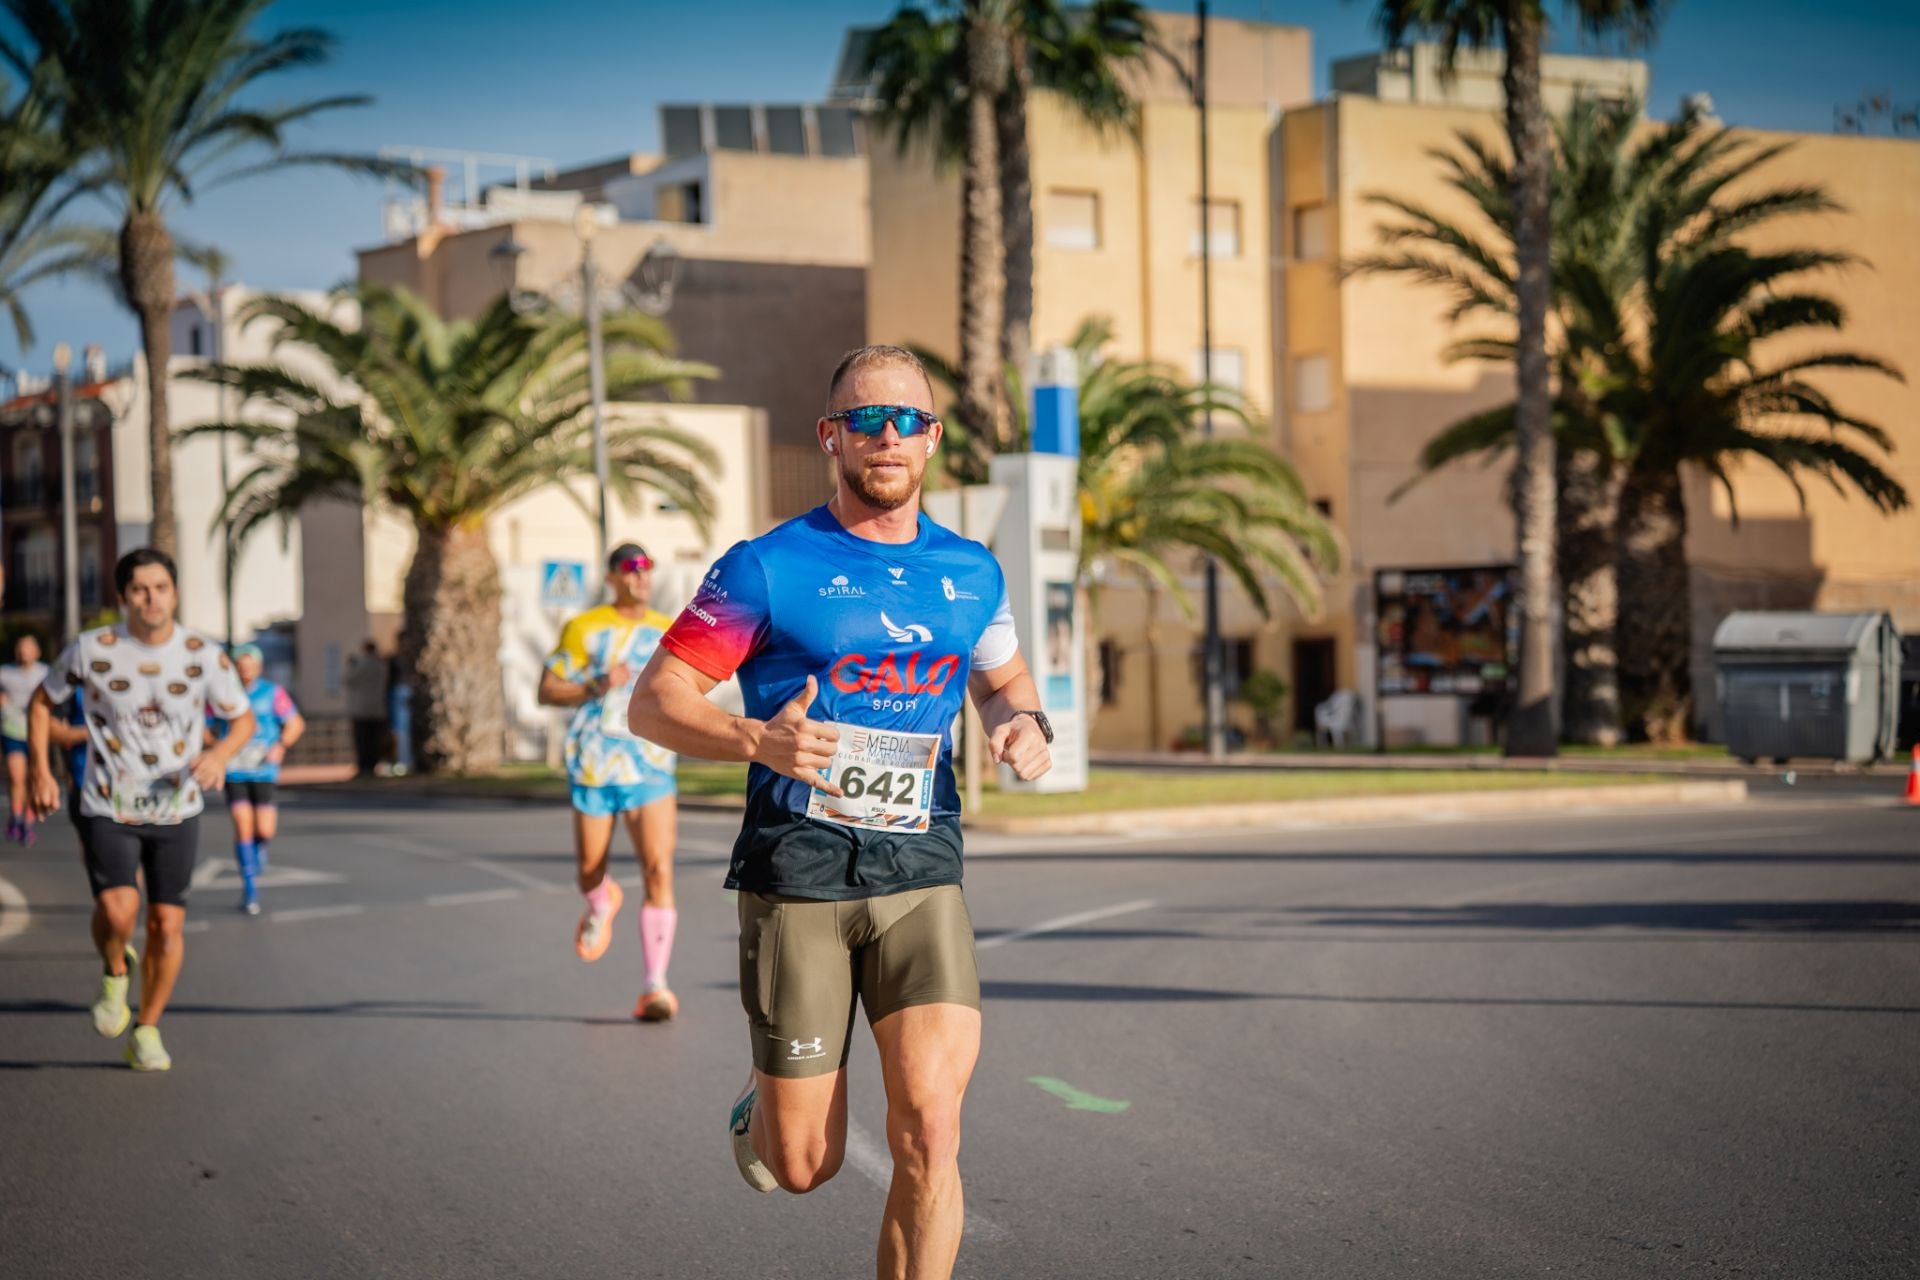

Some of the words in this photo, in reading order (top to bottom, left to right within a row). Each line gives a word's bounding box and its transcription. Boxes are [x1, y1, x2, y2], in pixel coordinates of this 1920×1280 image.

[818, 586, 866, 597] SPIRAL
[830, 651, 960, 695] GALO
[867, 734, 910, 753] MEDIA
[840, 766, 915, 805] 642
